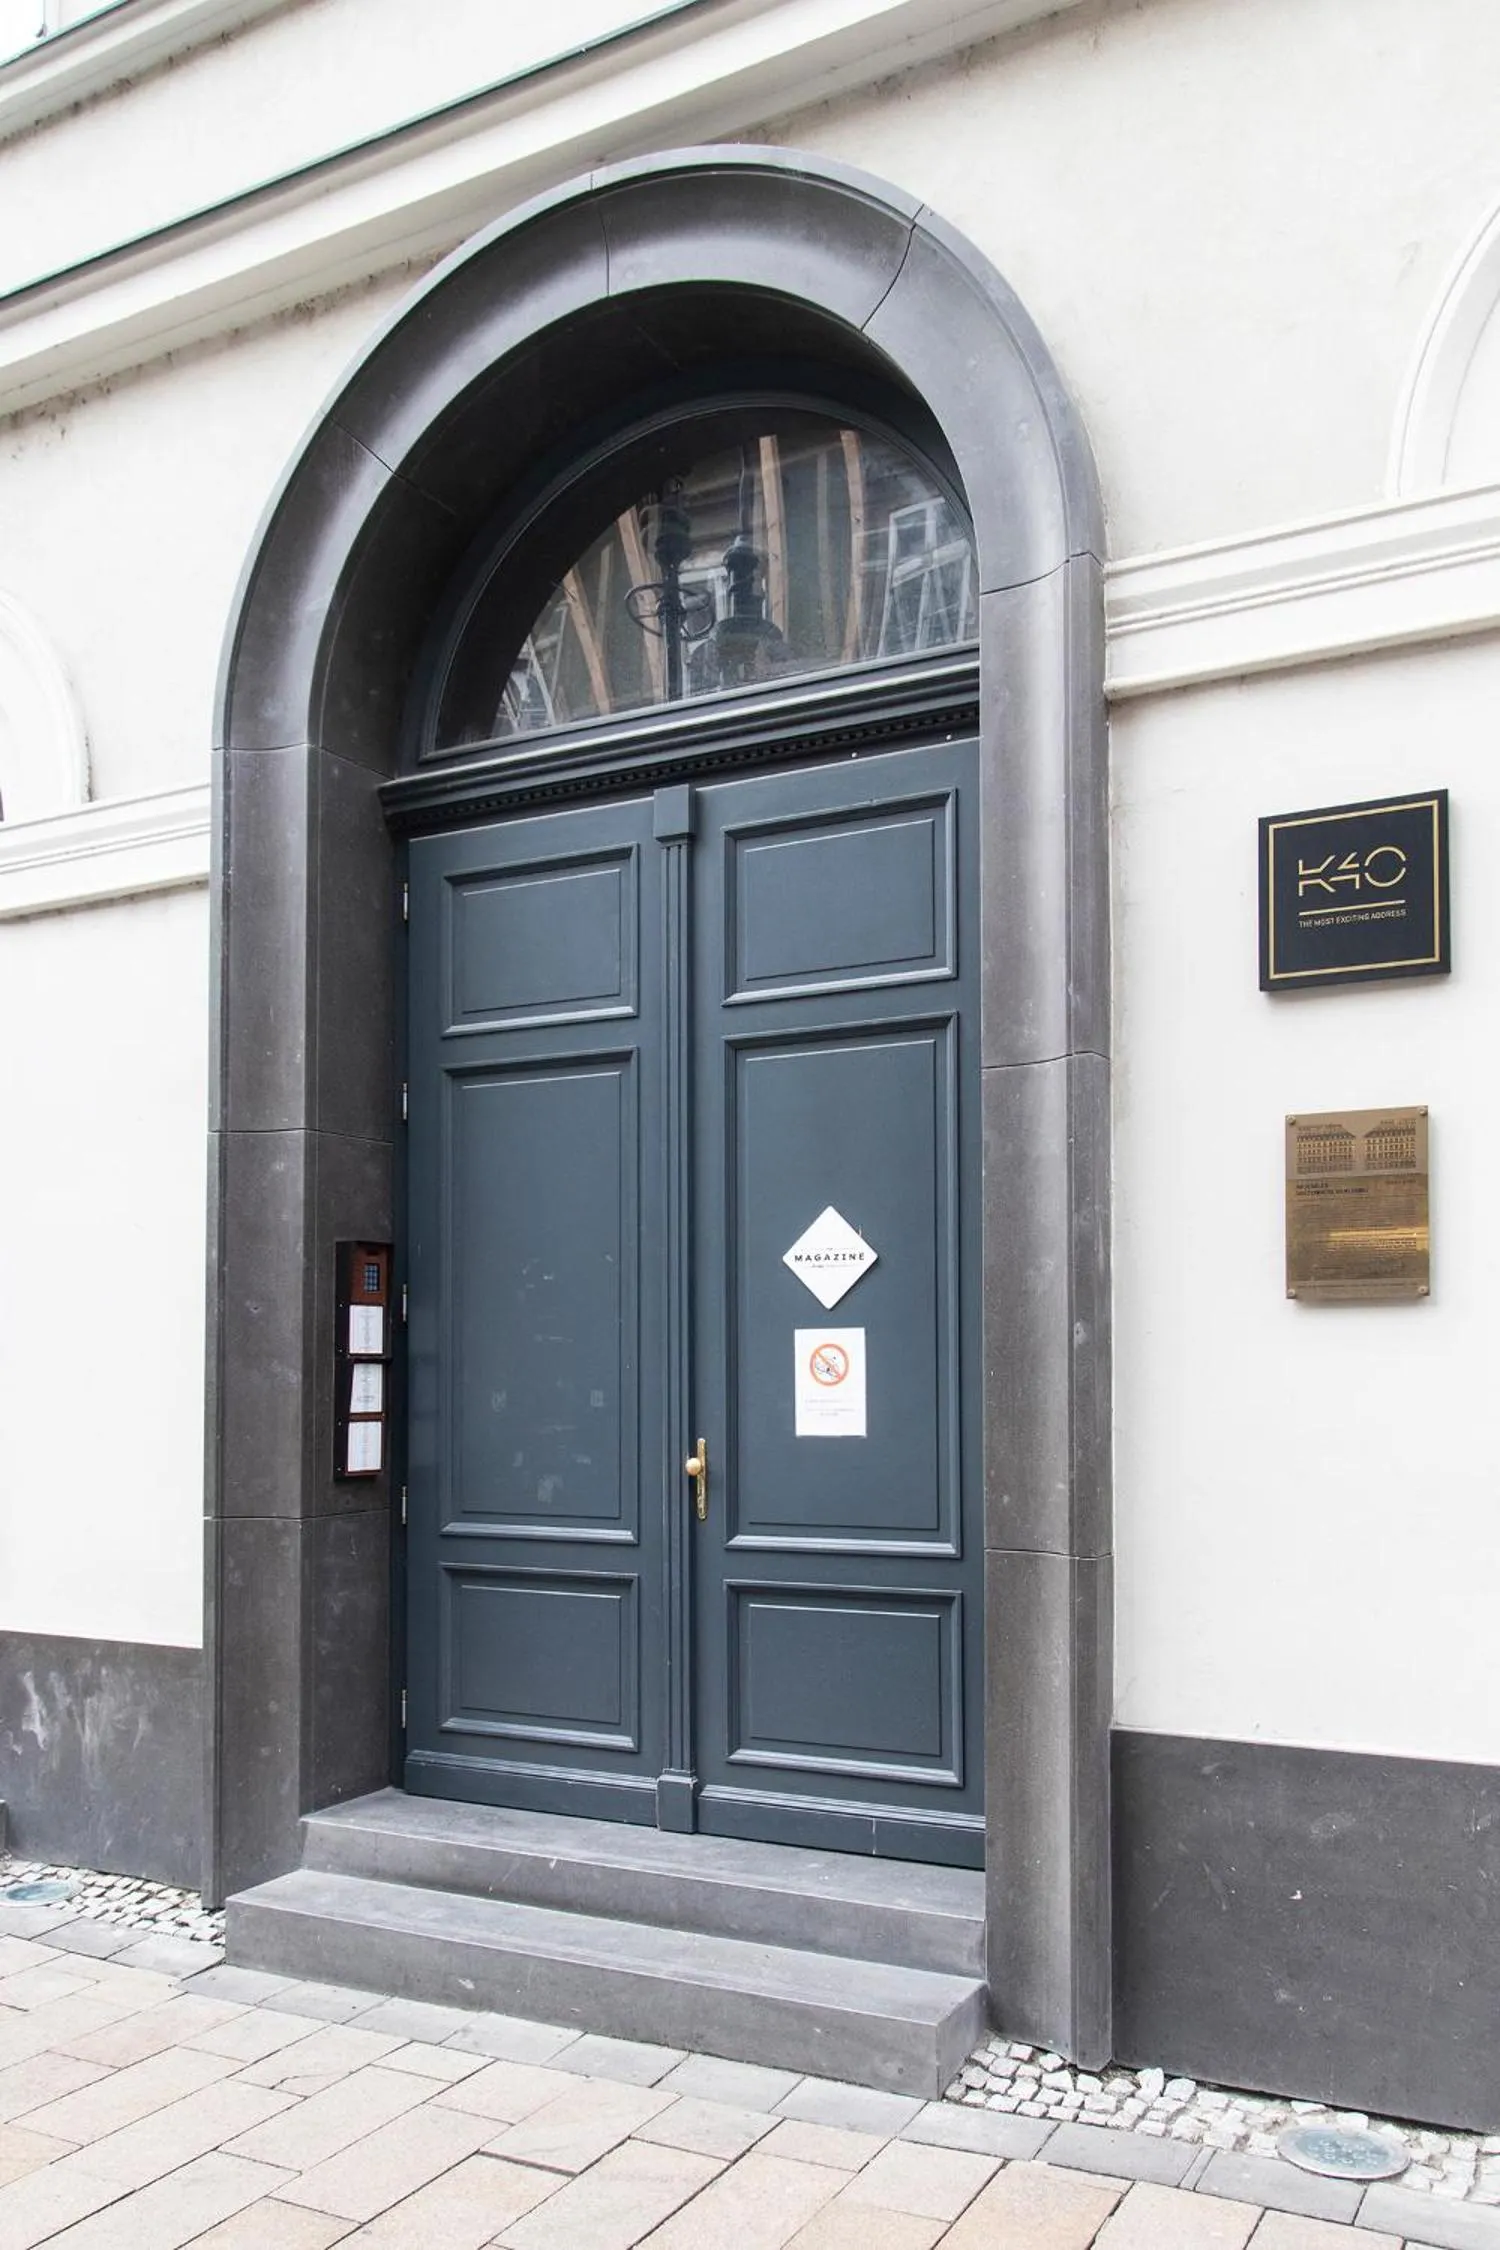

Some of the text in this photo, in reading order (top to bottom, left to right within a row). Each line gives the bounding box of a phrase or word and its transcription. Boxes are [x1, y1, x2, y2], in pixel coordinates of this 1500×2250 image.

[1299, 908, 1407, 929] THE MOST EXCITING ADDRESS
[794, 1252, 865, 1263] MAGAZINE
